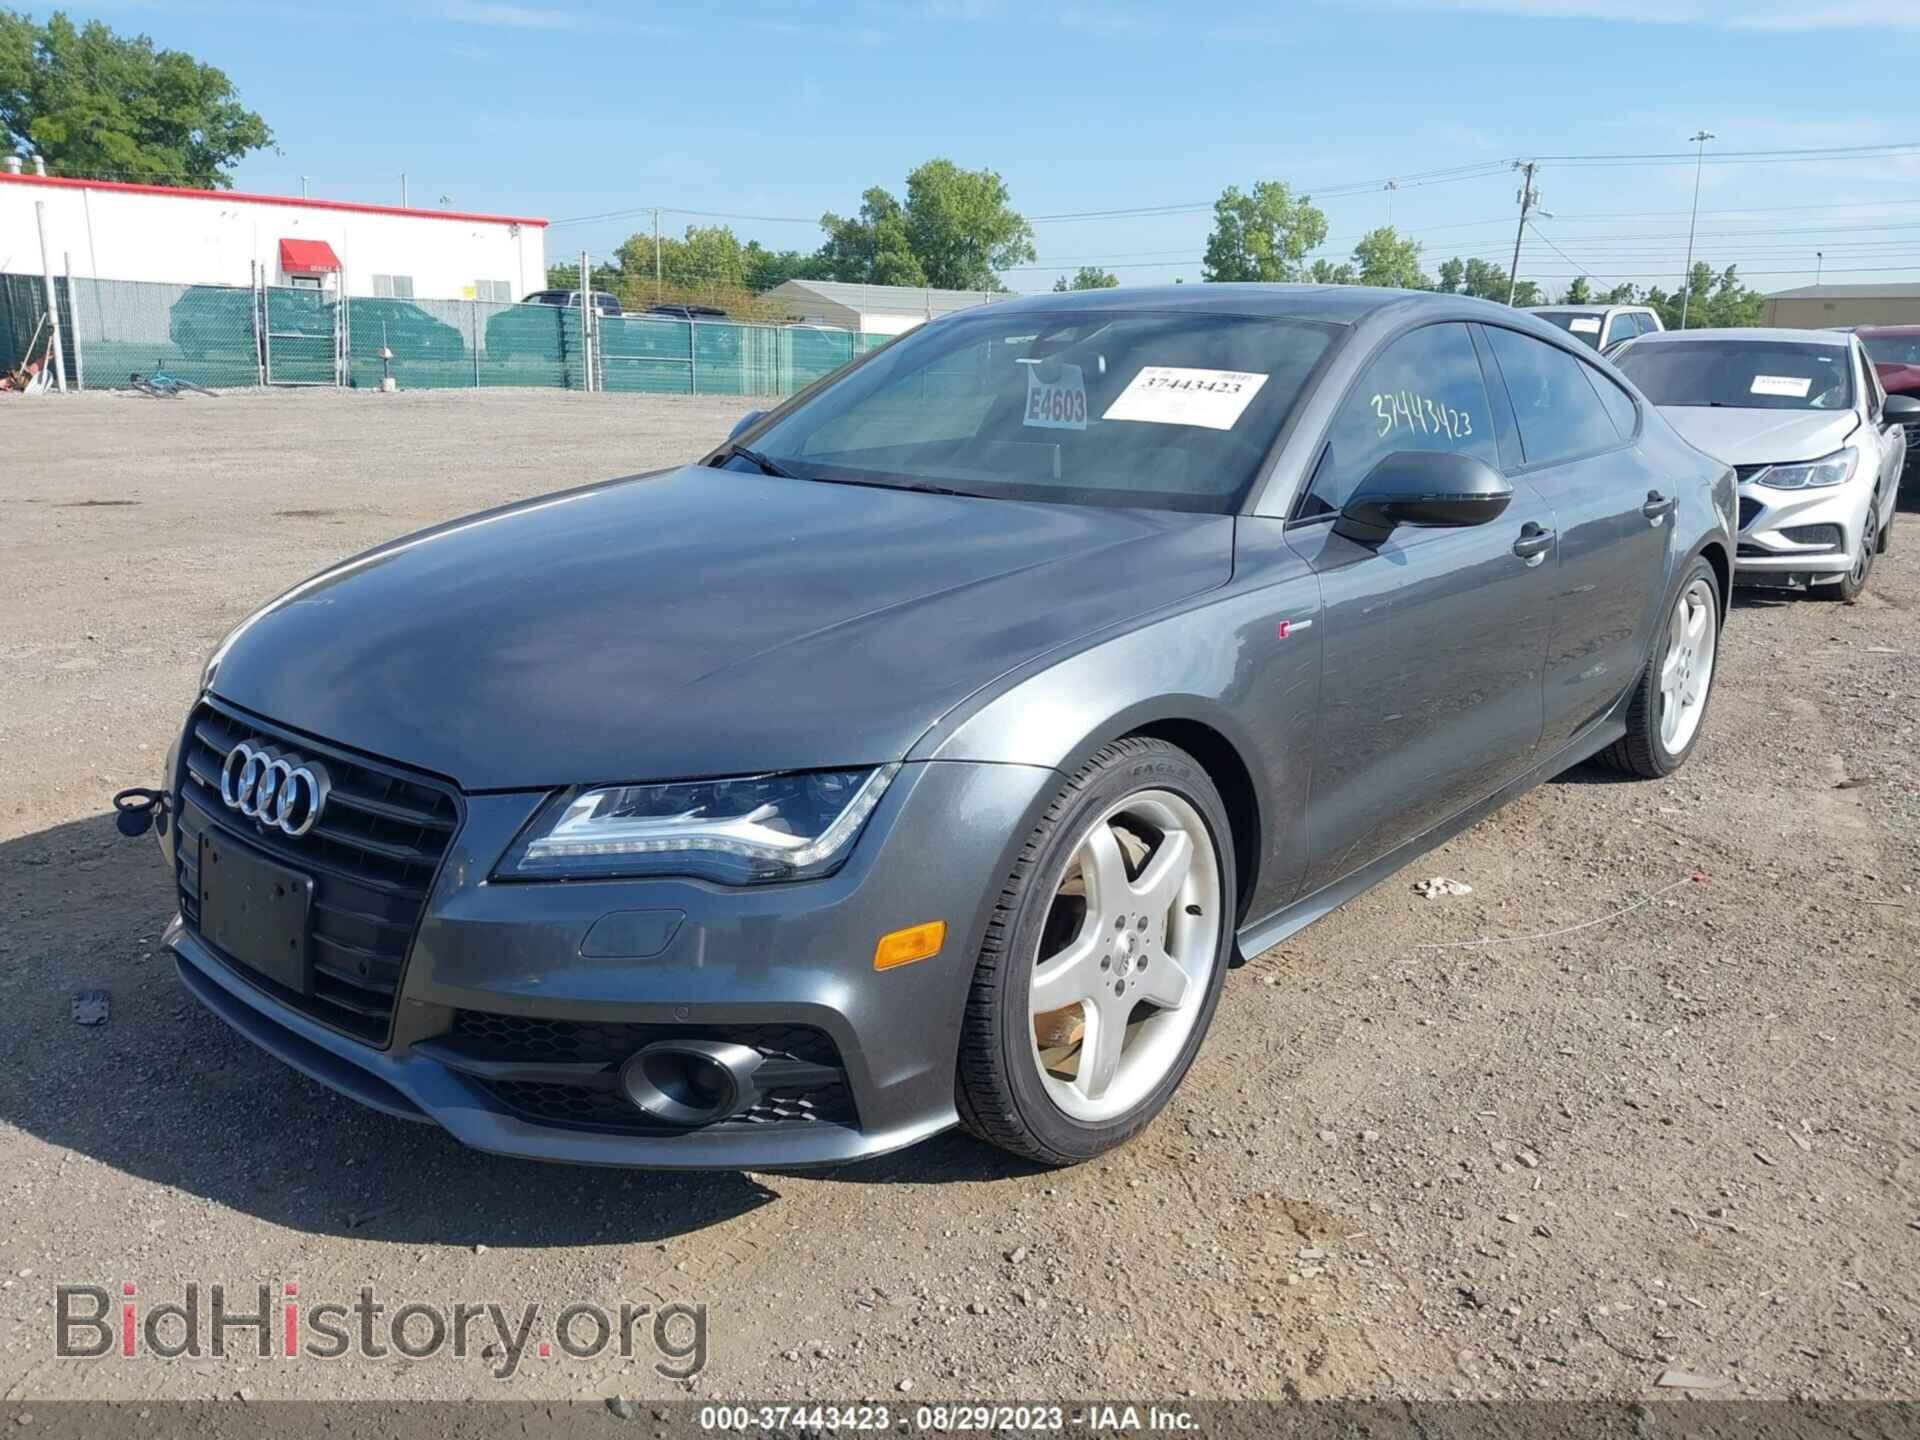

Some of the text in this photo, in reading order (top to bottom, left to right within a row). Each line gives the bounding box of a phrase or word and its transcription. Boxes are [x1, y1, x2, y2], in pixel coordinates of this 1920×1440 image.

[1140, 377, 1242, 394] 37443423
[1028, 389, 1086, 422] E4603
[1370, 390, 1473, 442] 37443423
